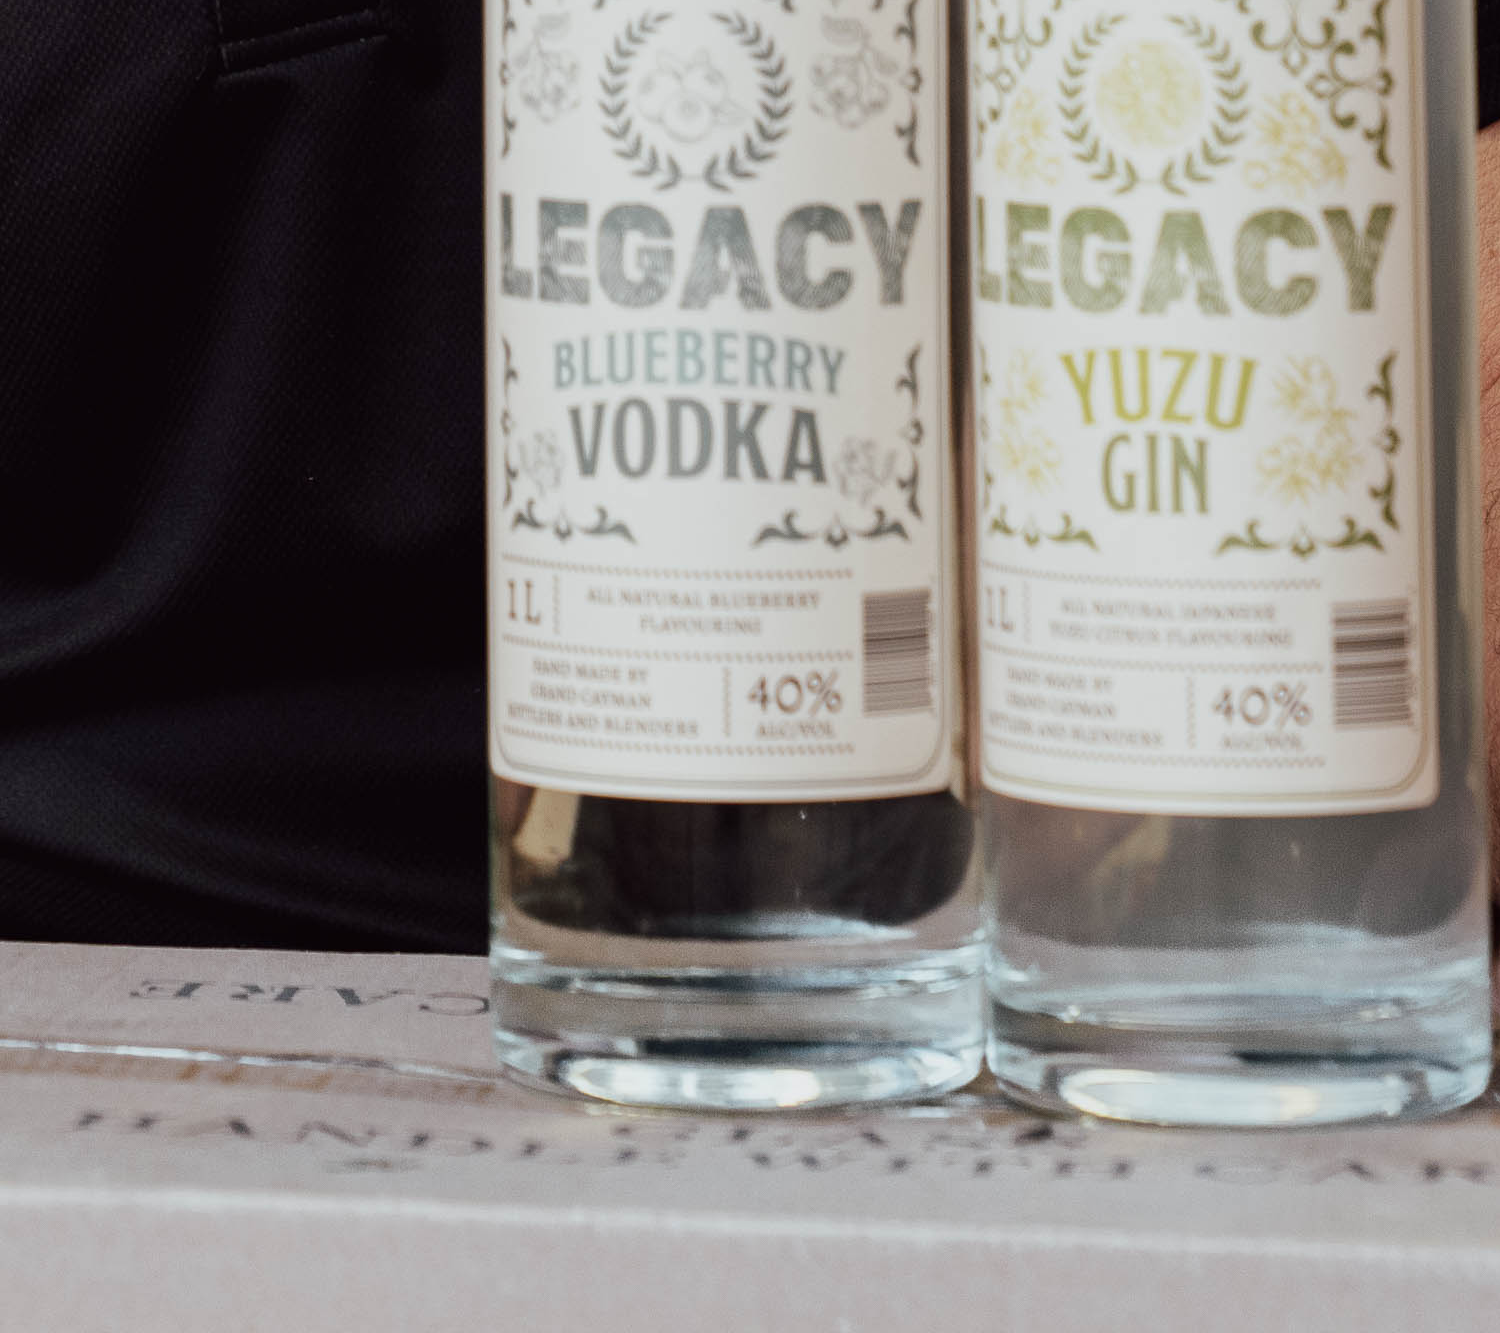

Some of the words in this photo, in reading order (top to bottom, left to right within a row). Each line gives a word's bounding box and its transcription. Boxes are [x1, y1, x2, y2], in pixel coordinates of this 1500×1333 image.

[499, 193, 923, 311] LEGACY
[975, 194, 1396, 317] LEGACY
[553, 329, 846, 396] BLUEBERRY
[1060, 347, 1257, 431] YUZU
[568, 397, 829, 485] VODKA
[1101, 433, 1211, 515] GIN
[507, 578, 542, 626] 1L
[618, 589, 704, 609] NATURAL
[709, 591, 821, 610] BLUEBERRY
[748, 669, 843, 717] 40%
[1212, 682, 1313, 729] 40%
[129, 980, 491, 1018] CARE
